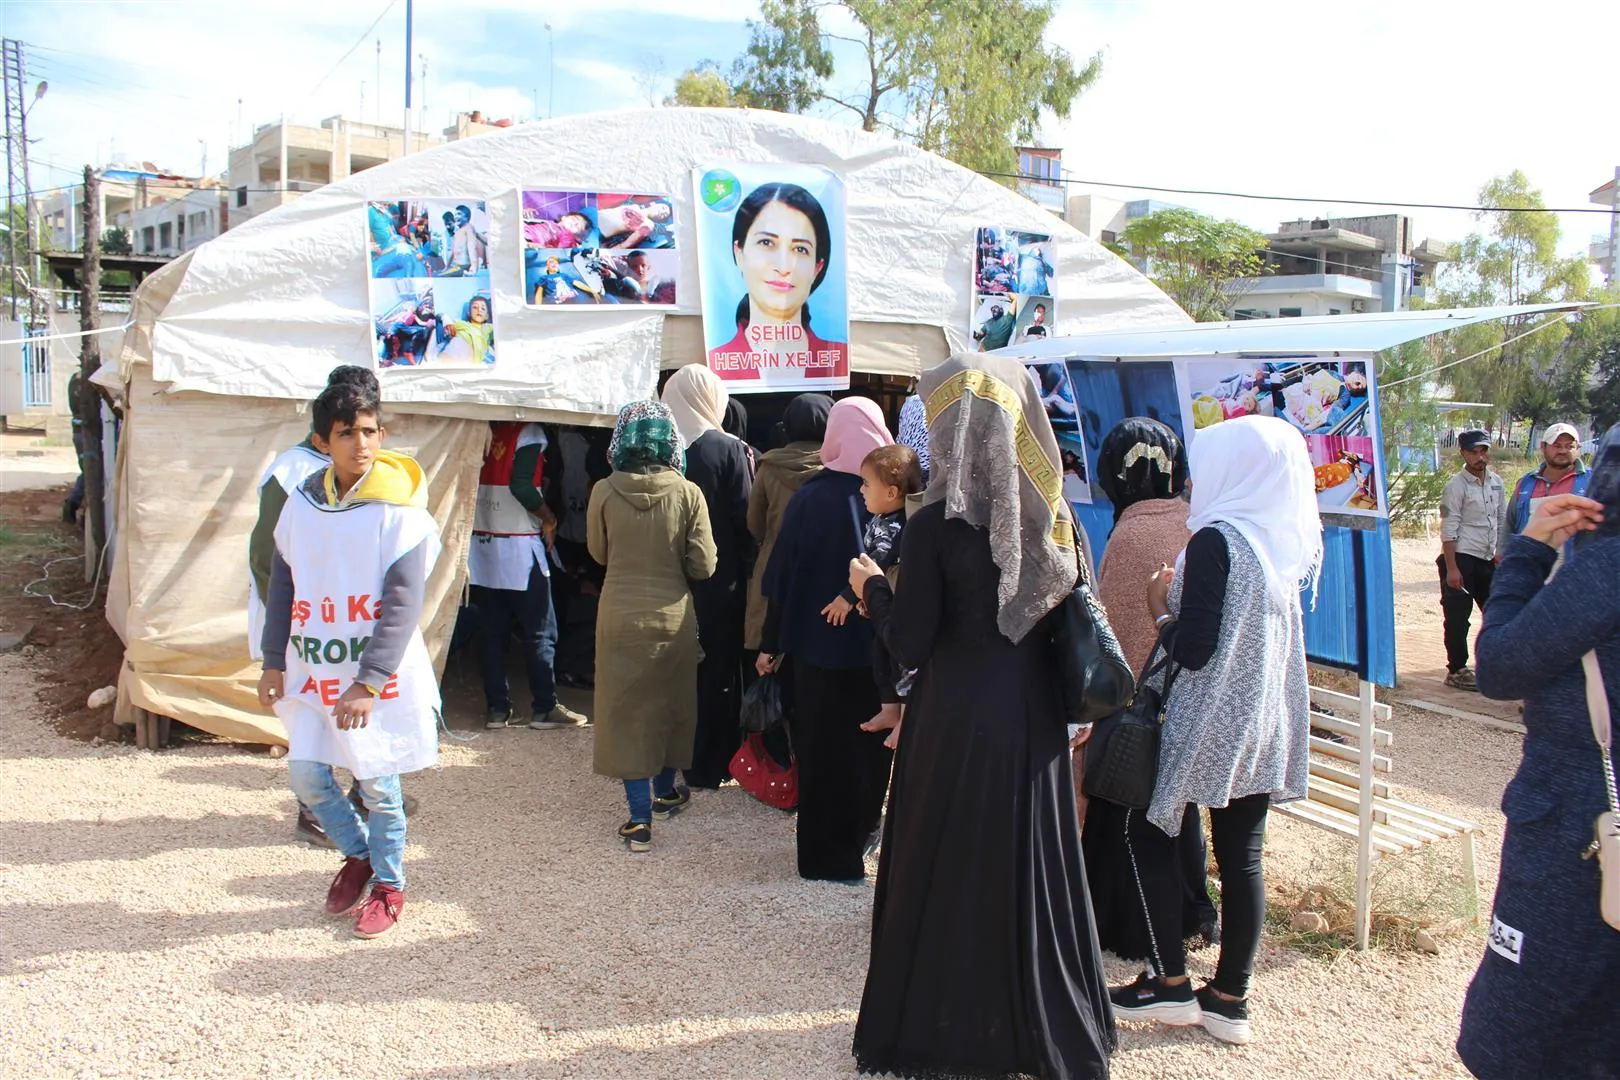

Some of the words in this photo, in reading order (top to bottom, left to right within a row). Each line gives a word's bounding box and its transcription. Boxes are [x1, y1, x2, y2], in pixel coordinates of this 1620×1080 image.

[751, 321, 802, 344] ŞEHÎD
[714, 348, 779, 370] HEVRÎN
[785, 349, 841, 369] XELEF
